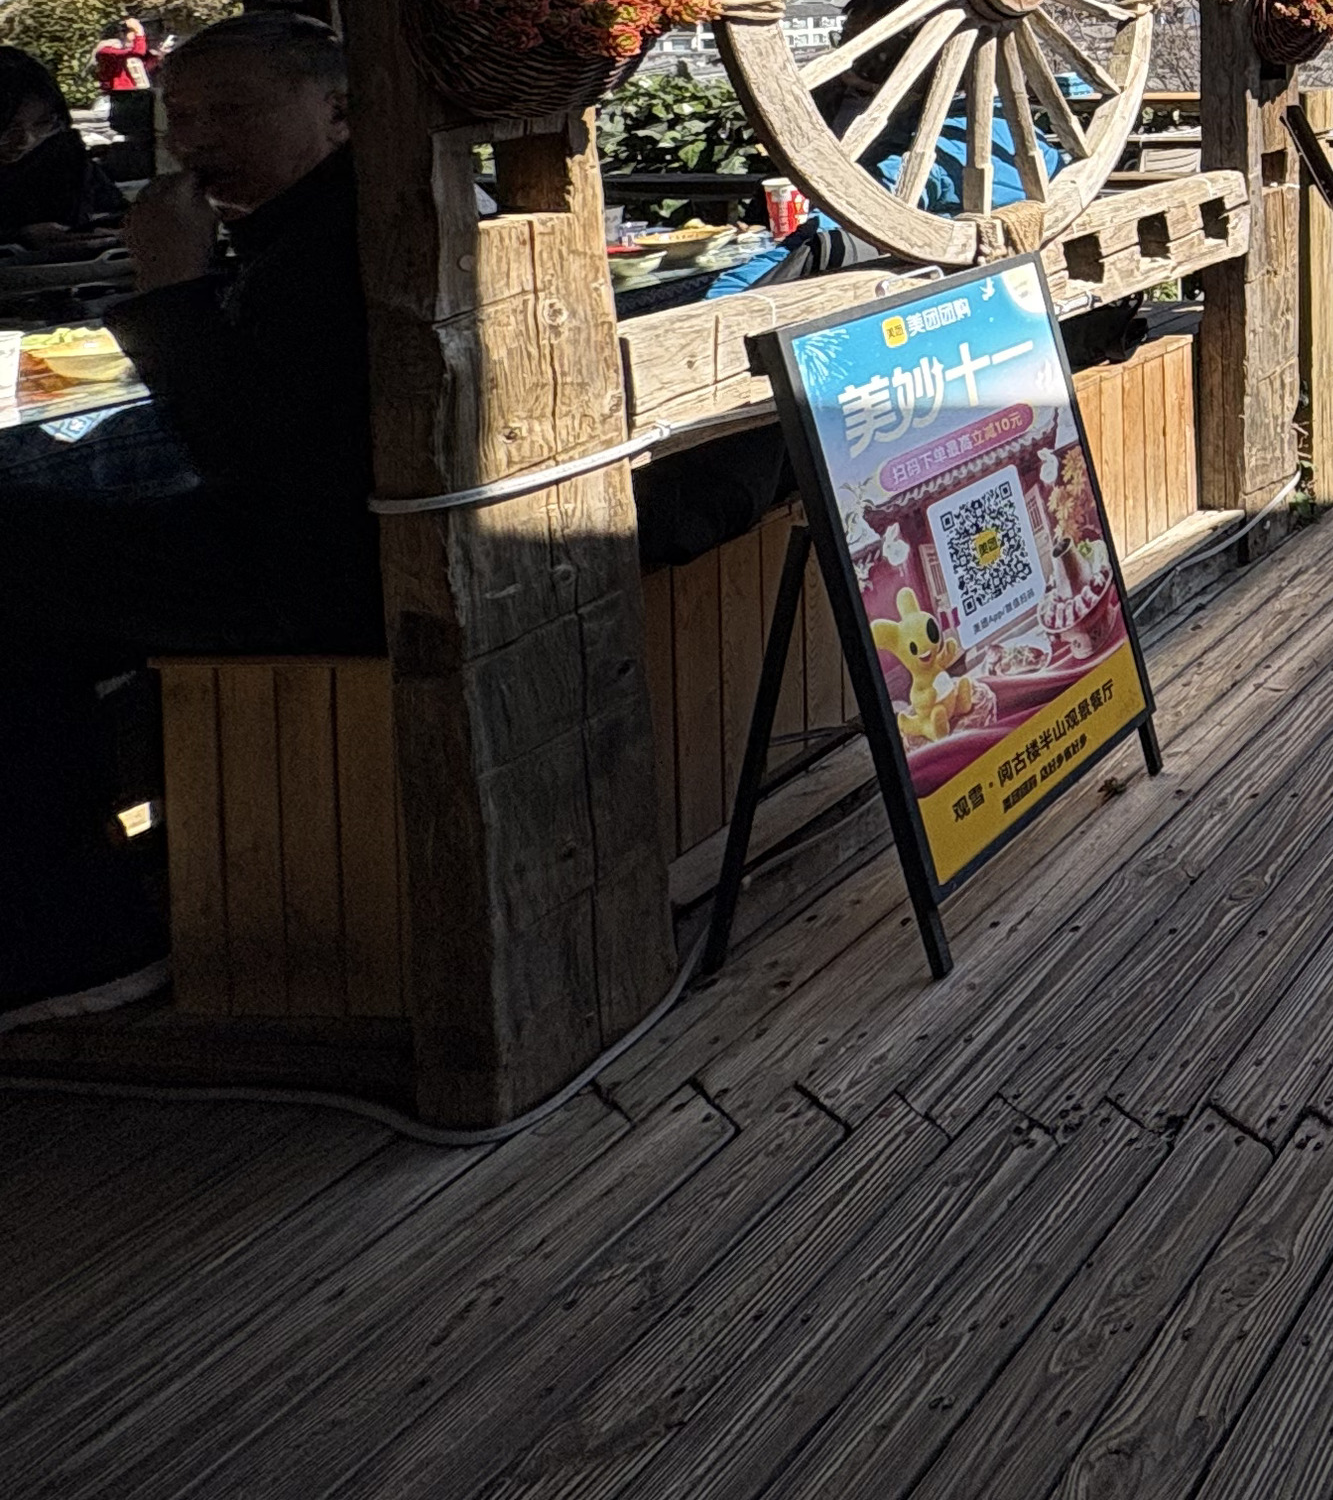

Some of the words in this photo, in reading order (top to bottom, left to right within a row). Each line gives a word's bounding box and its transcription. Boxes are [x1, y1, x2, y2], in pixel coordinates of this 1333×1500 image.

[906, 297, 972, 338] 美团团购
[837, 340, 1034, 459] 美妙十一
[891, 411, 1024, 486] 扫码下单最高立减10元
